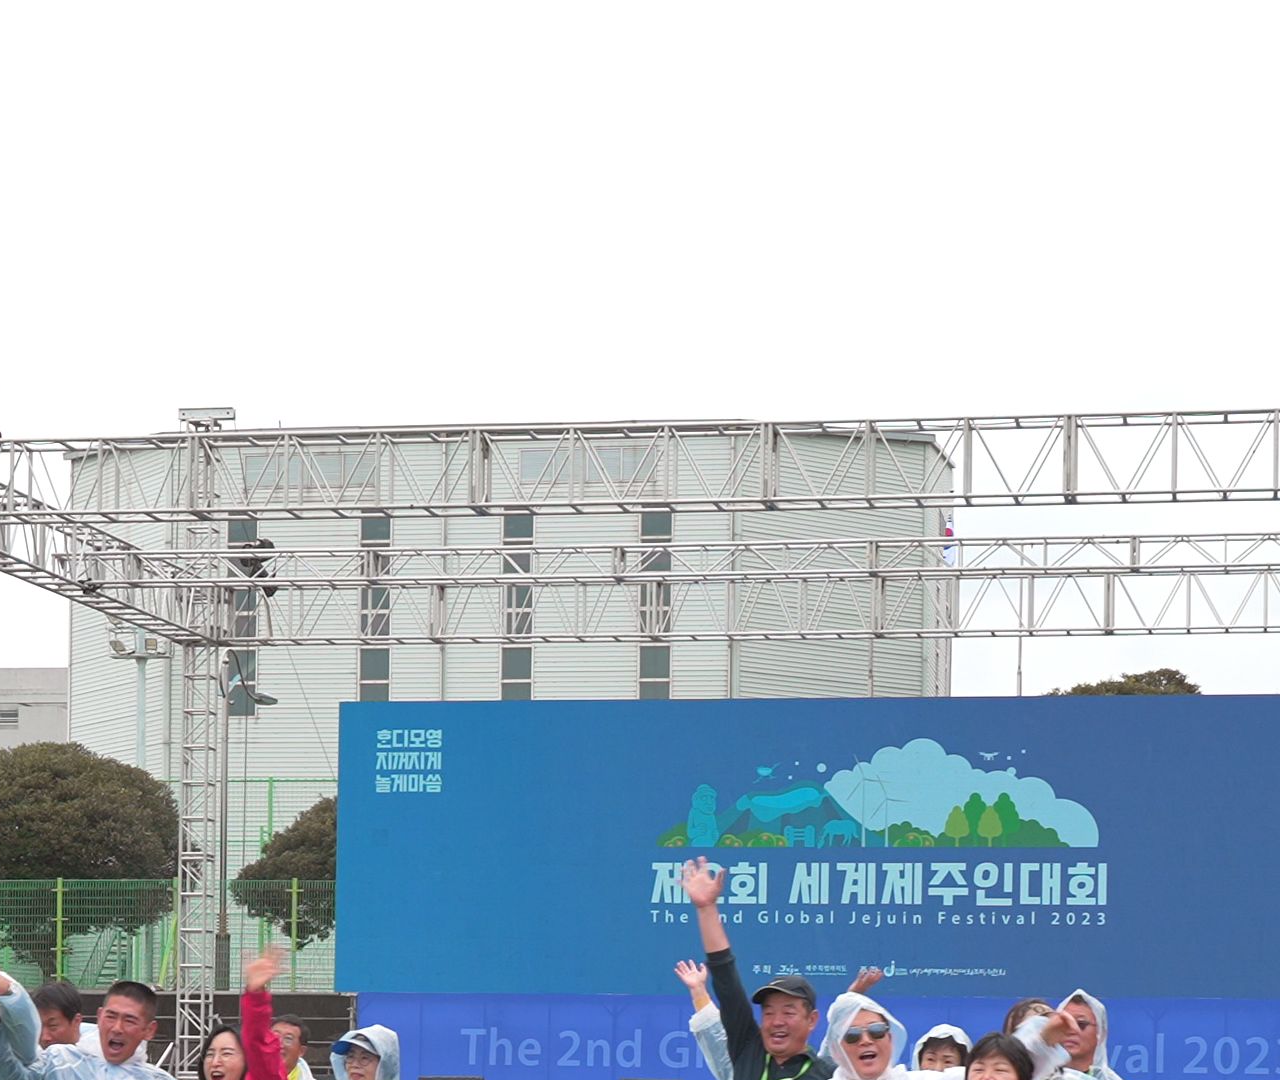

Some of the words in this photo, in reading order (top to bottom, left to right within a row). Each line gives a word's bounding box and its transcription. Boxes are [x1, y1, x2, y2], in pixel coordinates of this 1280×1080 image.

[375, 752, 442, 770] 지꺼지게
[375, 774, 442, 793] 놀게마씀
[788, 862, 1108, 906] 세계제주인대회
[650, 909, 689, 923] The
[757, 910, 835, 925] Global
[849, 911, 922, 928] Jejuin
[937, 911, 1036, 926] Festival
[1050, 912, 1107, 926] 2023
[460, 1027, 542, 1067] The
[557, 1029, 642, 1068] 2nd
